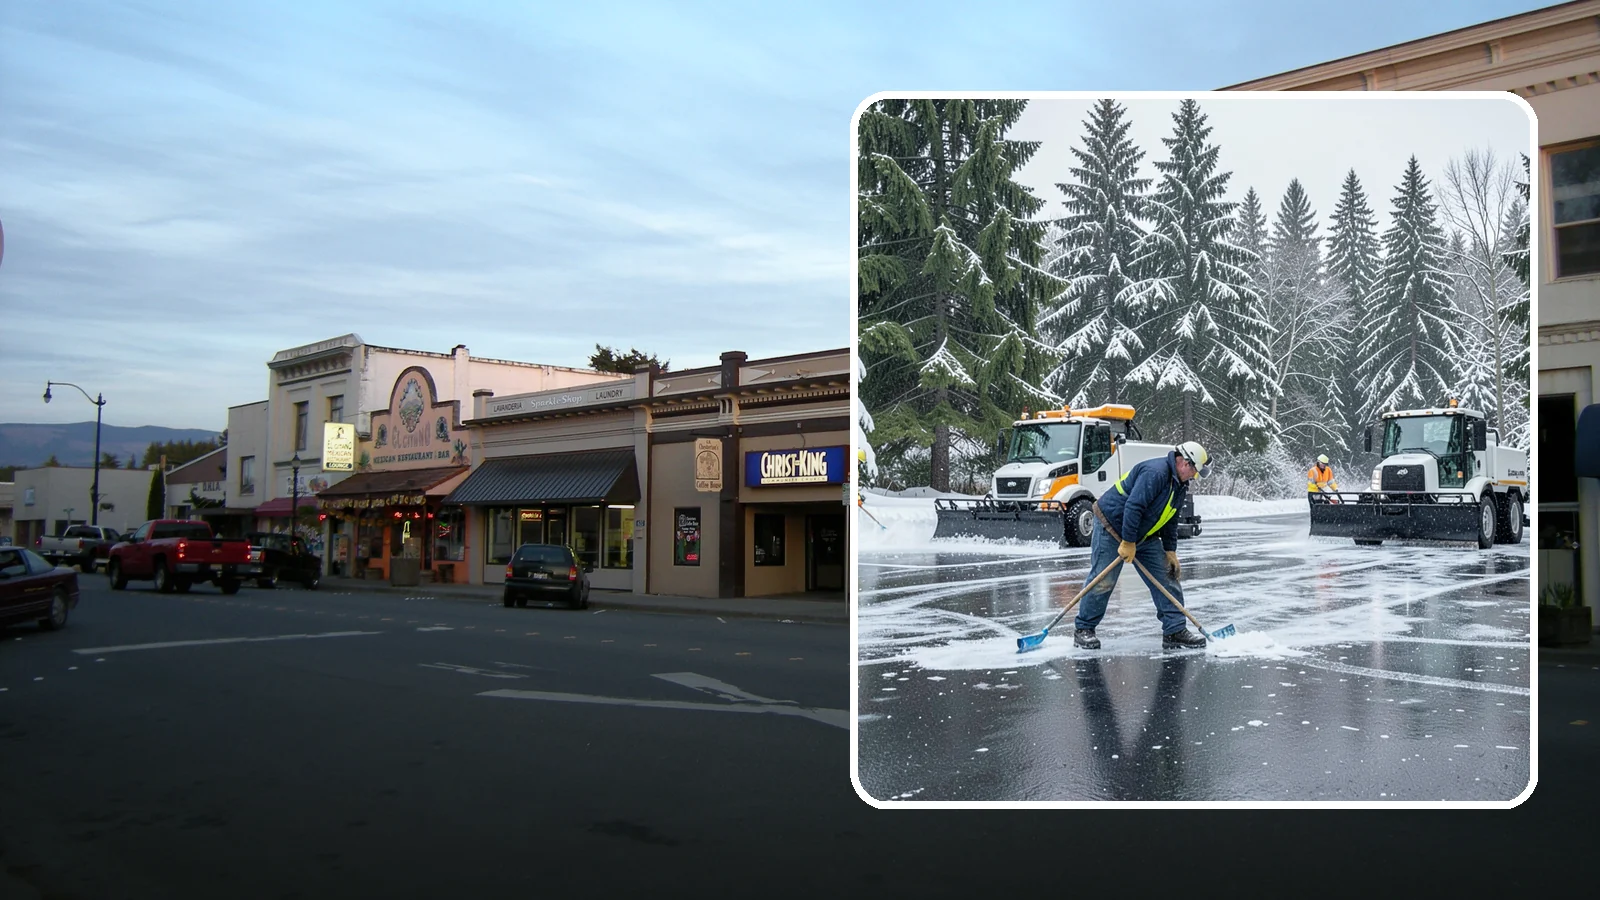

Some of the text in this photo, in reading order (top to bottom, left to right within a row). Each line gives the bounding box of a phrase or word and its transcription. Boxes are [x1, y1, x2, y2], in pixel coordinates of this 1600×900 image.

[493, 402, 522, 413] LAVANDERIA
[561, 394, 583, 405] Shop
[595, 389, 623, 400] LAUNDRY
[397, 451, 433, 462] RESTAURANT
[437, 450, 450, 459] BAR
[761, 452, 797, 478] CHRIST
[799, 450, 827, 476] KING
